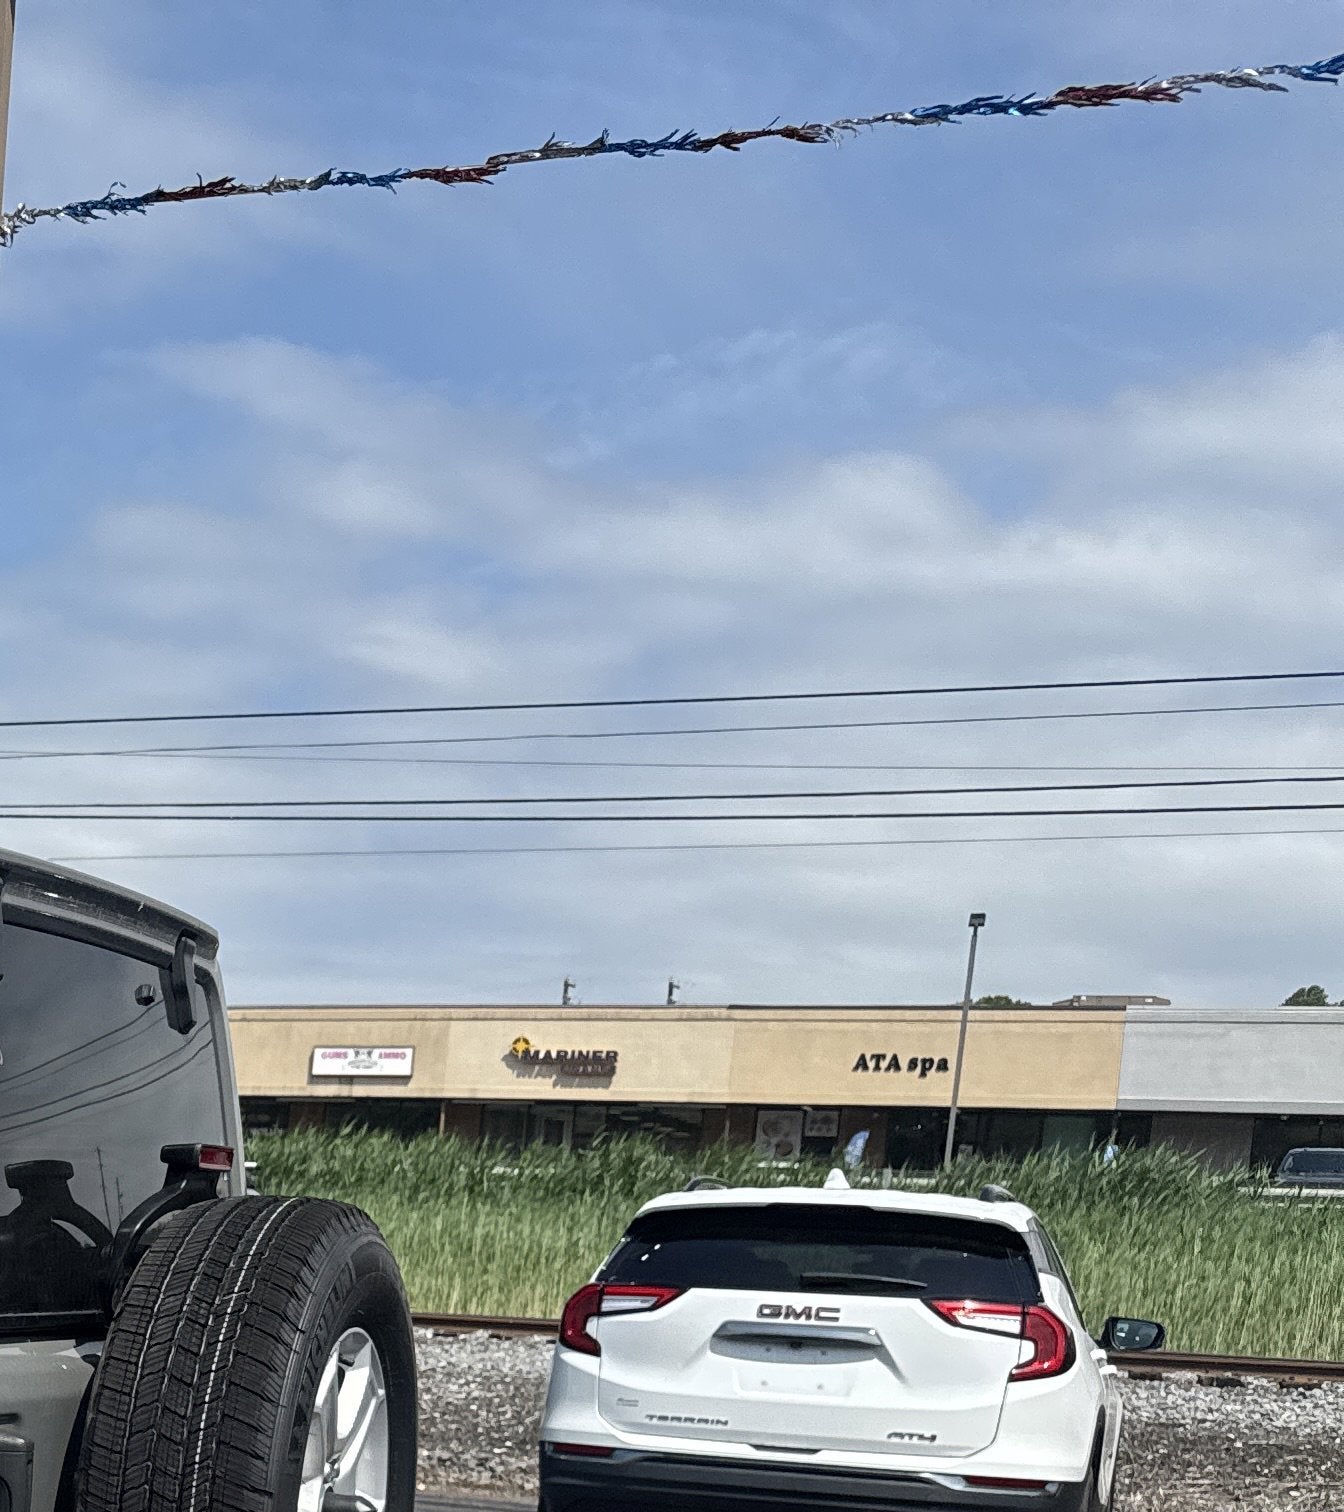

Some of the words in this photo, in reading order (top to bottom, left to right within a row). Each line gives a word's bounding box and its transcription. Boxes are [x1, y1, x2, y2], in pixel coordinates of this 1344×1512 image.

[520, 1049, 619, 1063] MARINER
[852, 1053, 901, 1072] ATA
[907, 1057, 949, 1079] spa
[756, 1303, 841, 1323] GMC
[645, 1413, 730, 1426] TERRAIN
